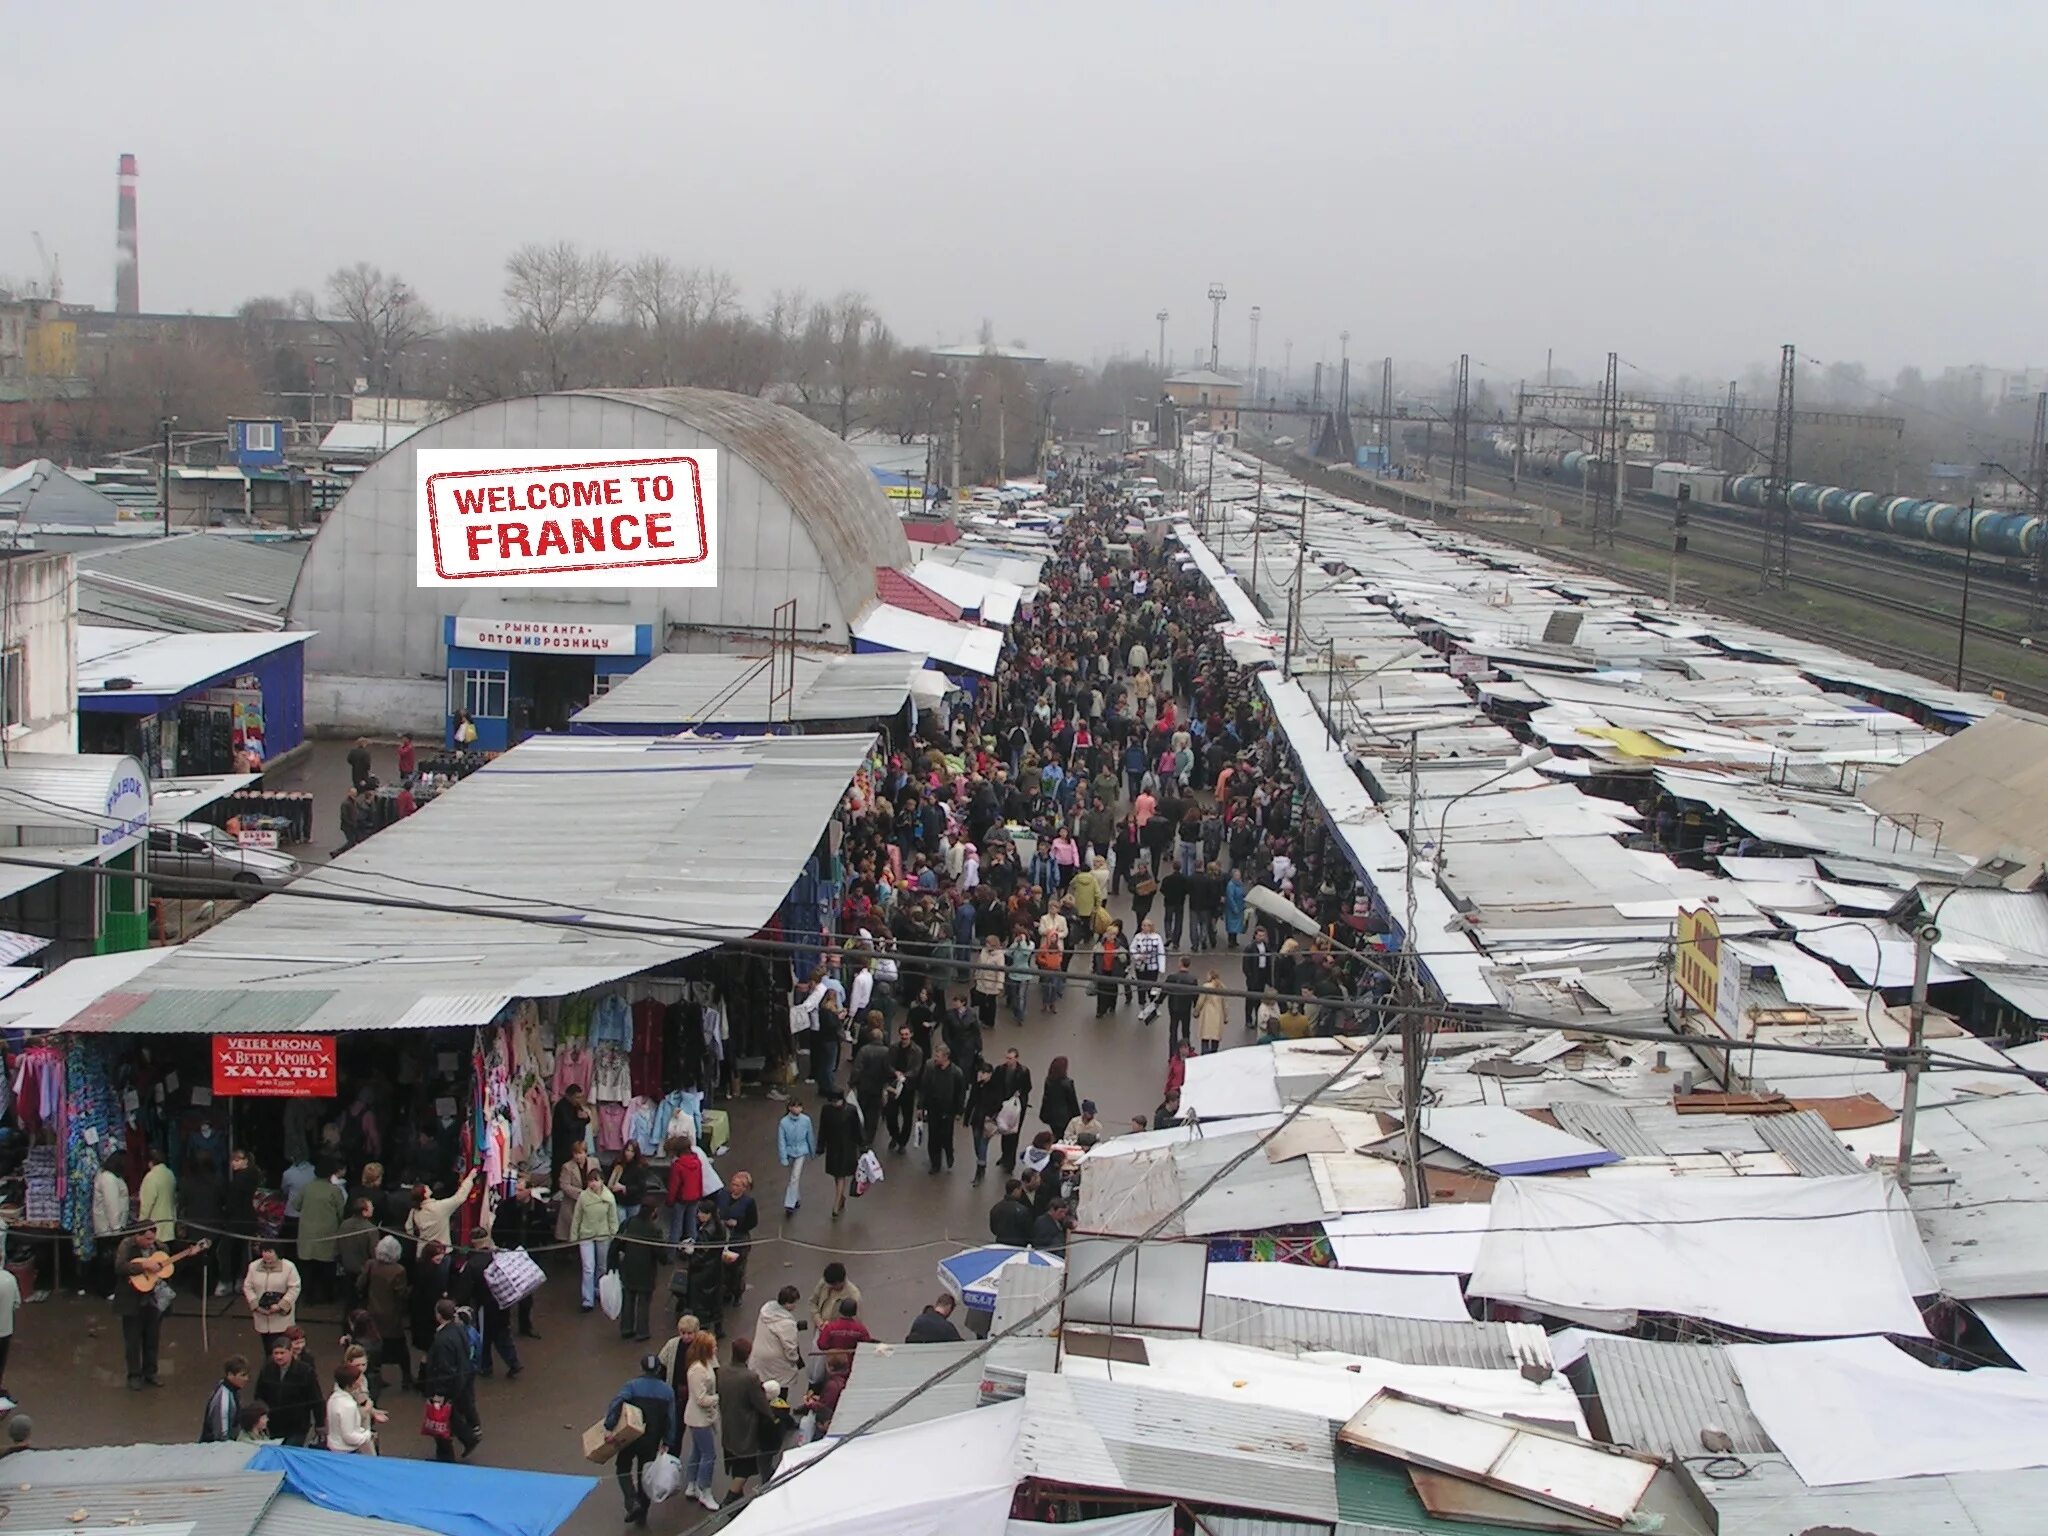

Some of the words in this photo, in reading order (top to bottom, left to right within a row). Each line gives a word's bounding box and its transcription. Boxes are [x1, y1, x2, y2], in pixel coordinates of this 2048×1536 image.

[504, 622, 549, 634] РЫНОК
[227, 1038, 270, 1050] VETER
[271, 1039, 323, 1050] KRONA
[223, 1065, 328, 1079] ХАЛАТЫ
